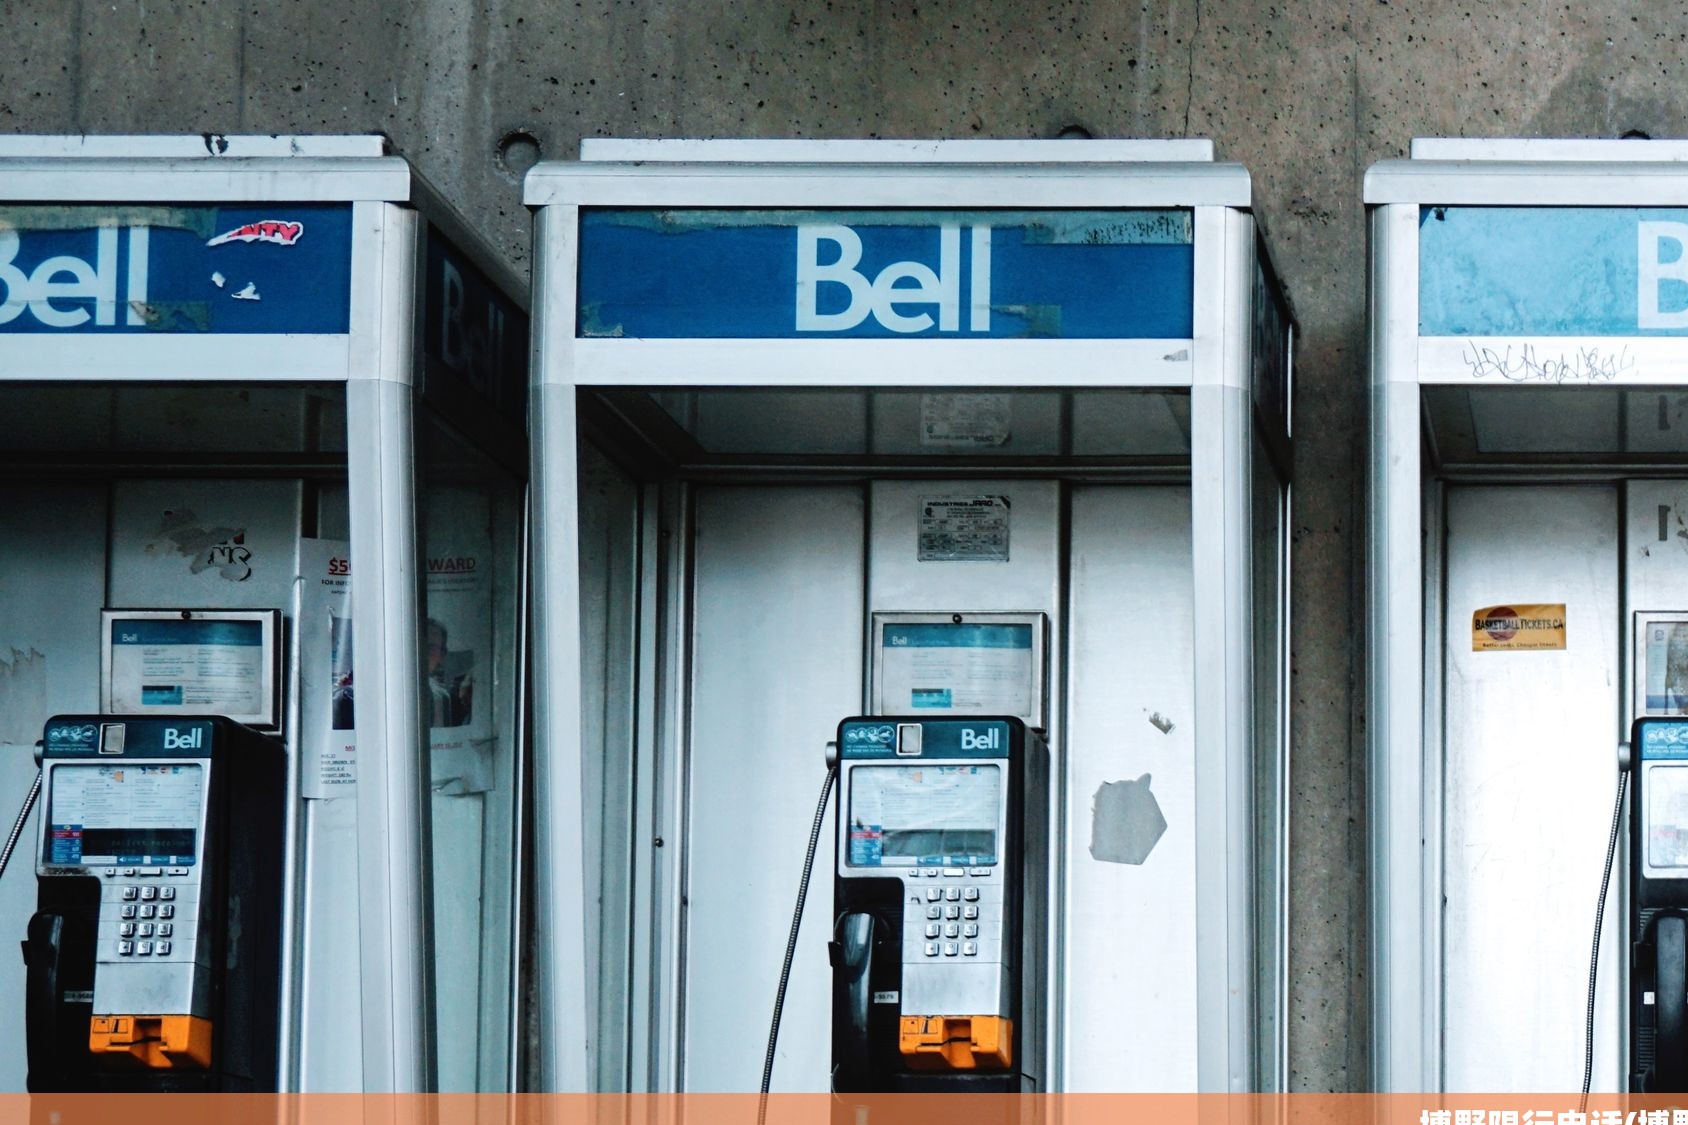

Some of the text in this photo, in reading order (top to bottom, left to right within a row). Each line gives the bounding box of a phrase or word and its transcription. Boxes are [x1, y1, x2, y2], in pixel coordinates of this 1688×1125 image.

[796, 224, 991, 333] Bell
[328, 557, 352, 574] $5
[1475, 619, 1564, 631] BASKETBALLTICKETS.CA
[122, 633, 138, 642] Bell
[892, 636, 907, 645] Bell
[164, 728, 202, 749] Bell
[961, 728, 999, 750] Bell
